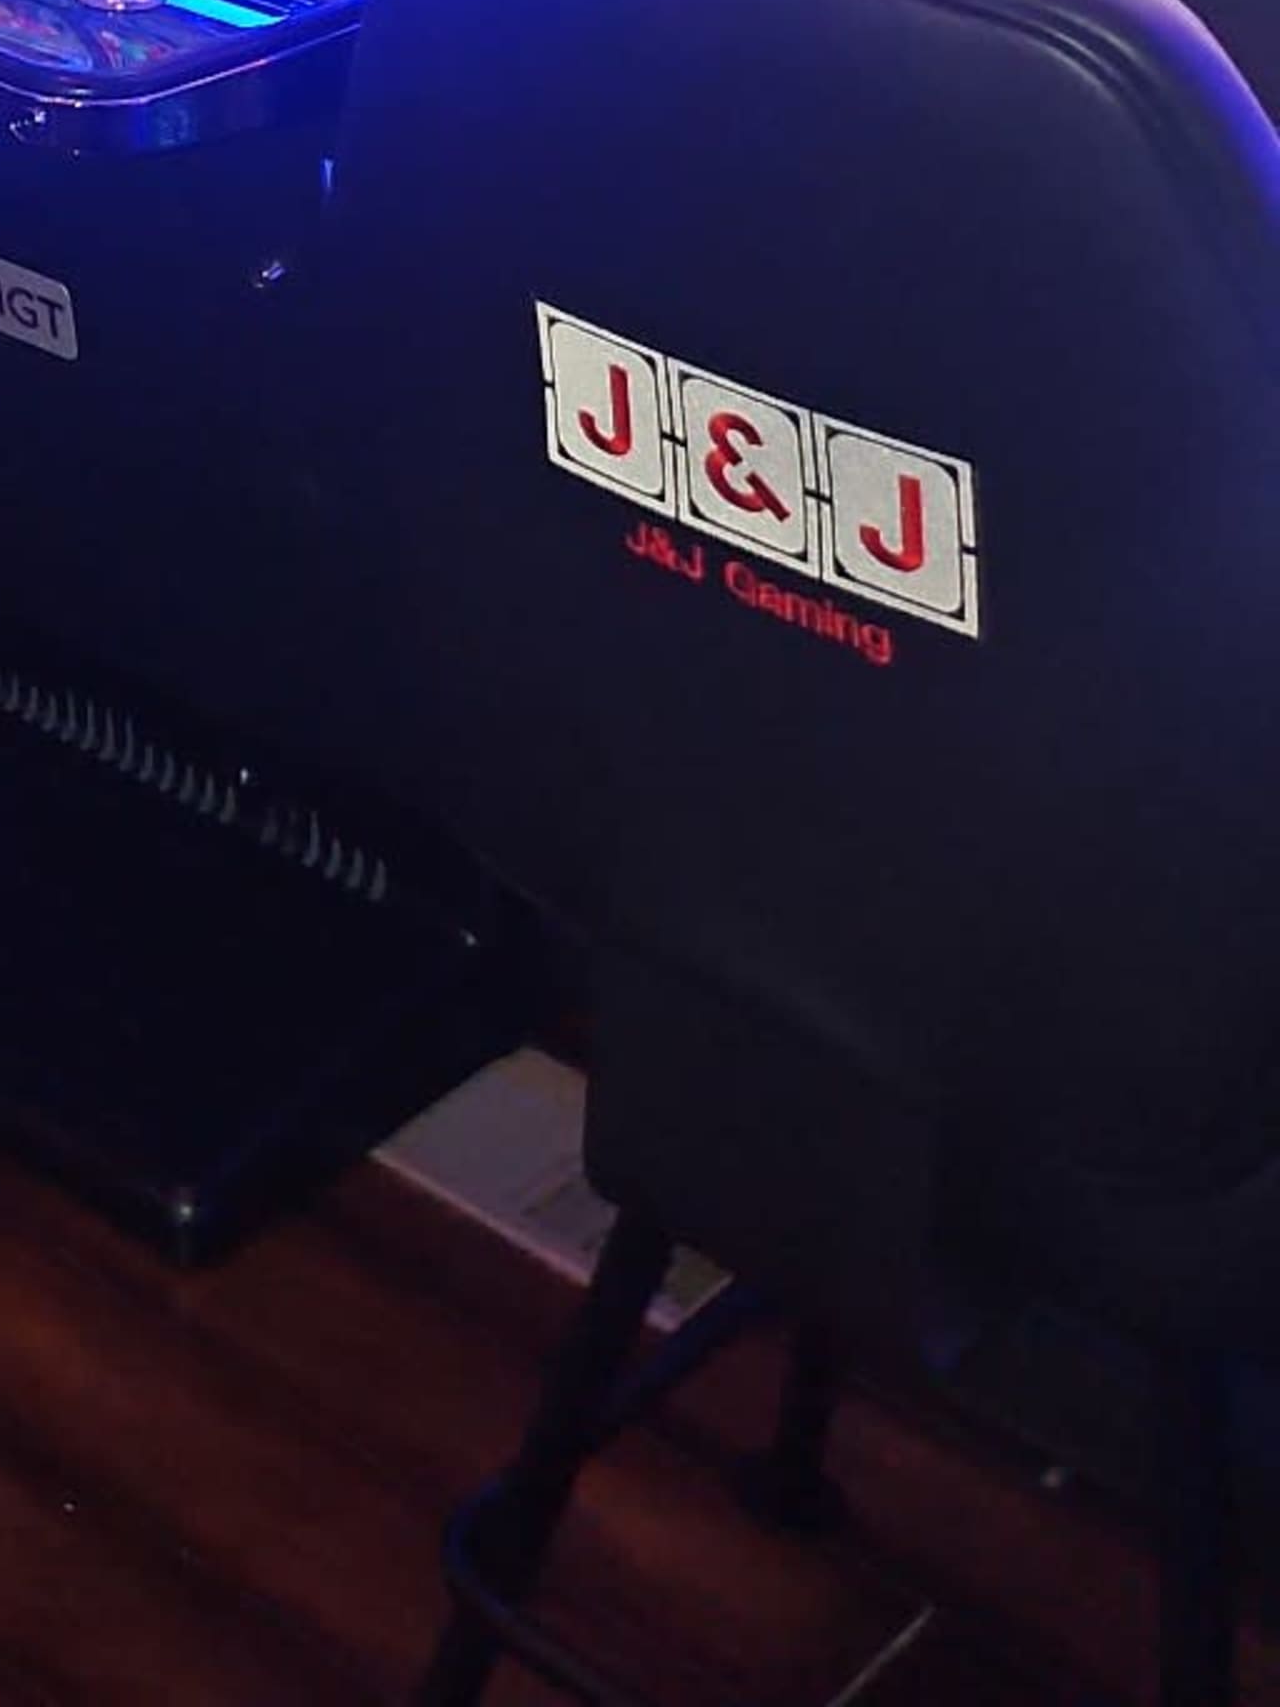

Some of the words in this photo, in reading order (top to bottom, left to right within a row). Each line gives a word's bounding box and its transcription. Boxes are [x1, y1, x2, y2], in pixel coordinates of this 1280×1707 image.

[577, 363, 634, 458] J
[703, 411, 792, 523] &
[858, 472, 924, 573] J
[624, 521, 704, 582] J&J
[722, 559, 895, 665] Gaming
